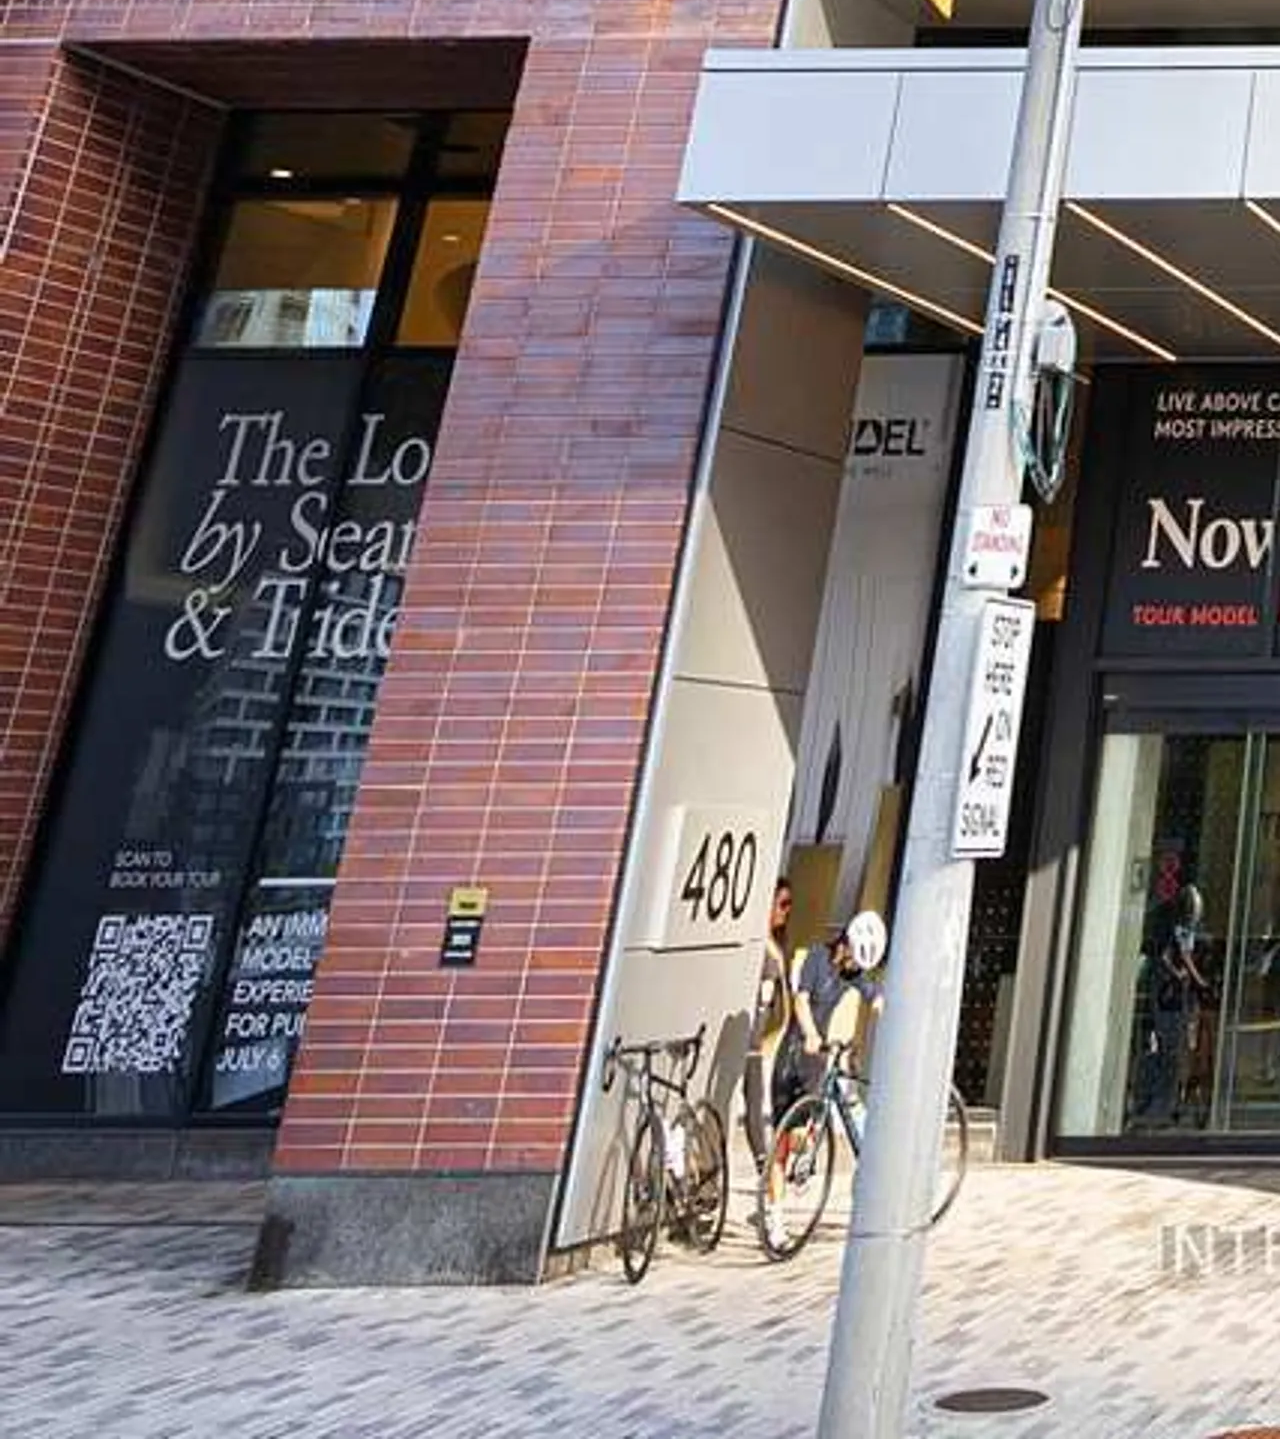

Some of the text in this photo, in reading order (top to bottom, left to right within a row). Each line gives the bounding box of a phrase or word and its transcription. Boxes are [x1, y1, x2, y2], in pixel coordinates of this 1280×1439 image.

[1154, 419, 1204, 439] MOST
[1157, 392, 1197, 412] LIVE
[1200, 392, 1261, 412] ABOVE
[216, 410, 331, 485] The
[180, 489, 262, 594] by
[164, 588, 233, 660] &
[1132, 605, 1186, 625] TOUR
[1189, 605, 1258, 625] MODEL
[681, 832, 756, 922] 480
